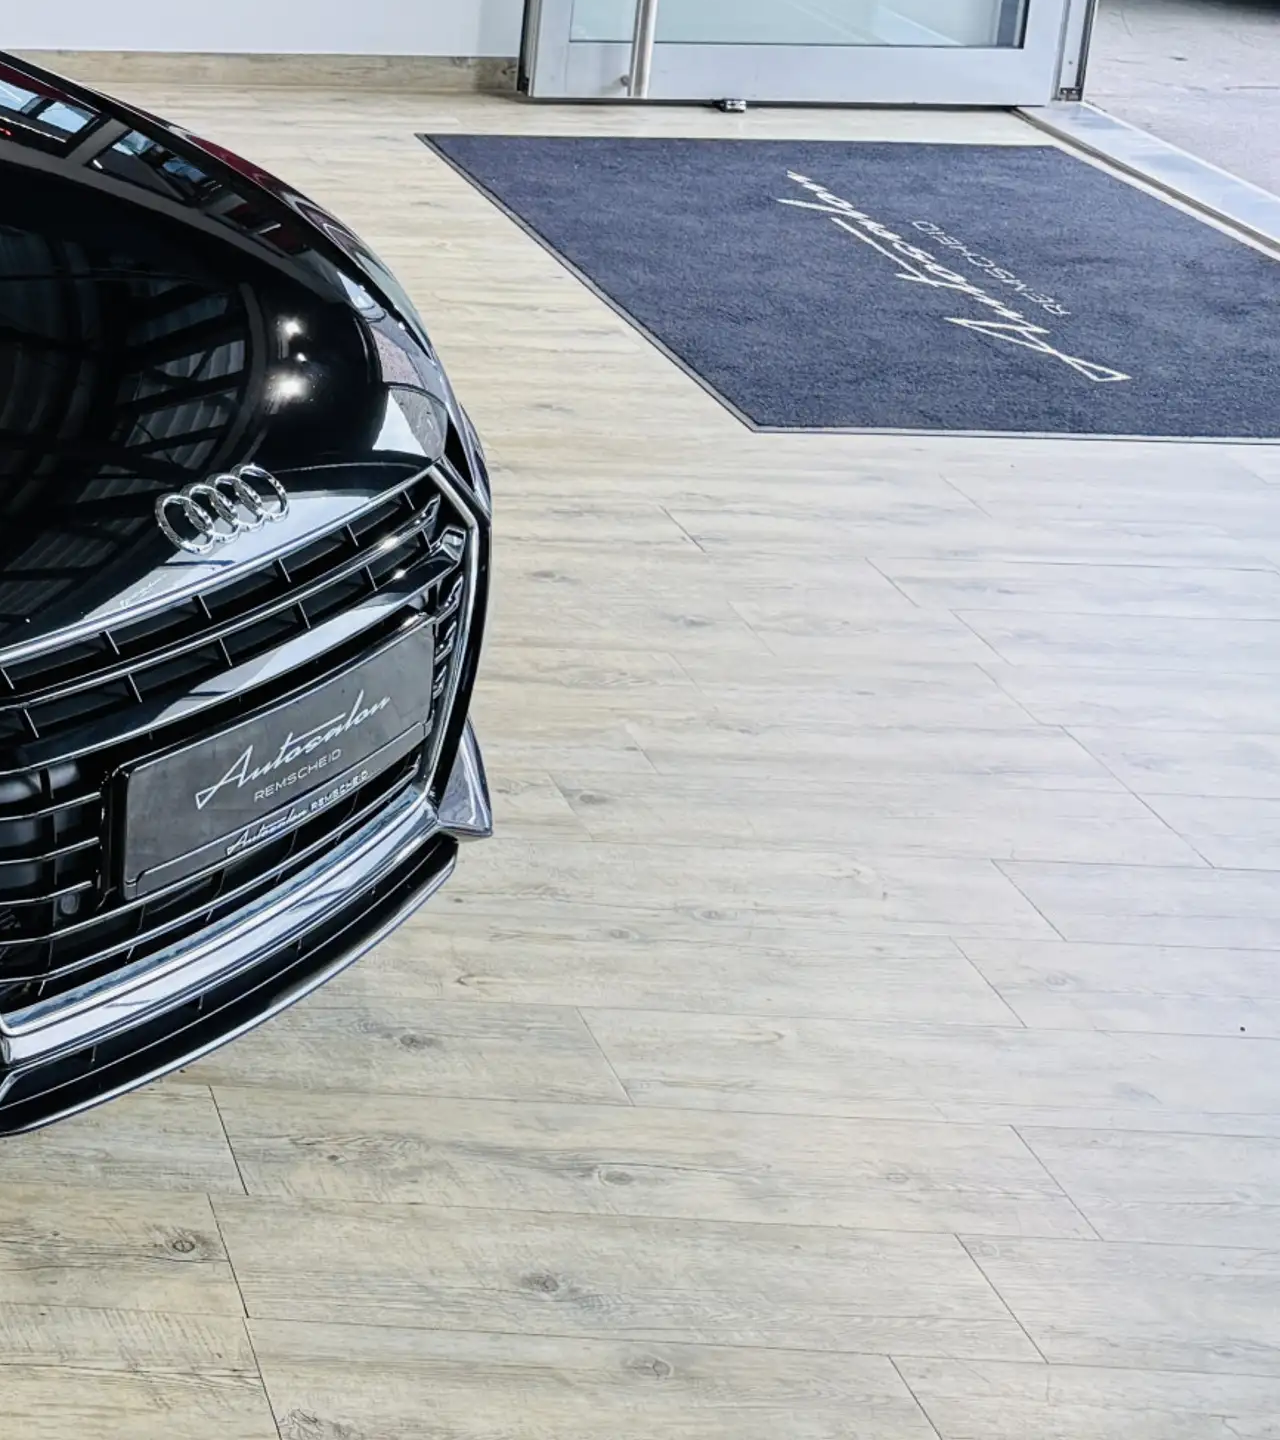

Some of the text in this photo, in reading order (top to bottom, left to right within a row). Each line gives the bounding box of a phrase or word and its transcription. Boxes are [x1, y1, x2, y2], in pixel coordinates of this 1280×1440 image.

[778, 170, 1132, 382] Autosalon
[912, 220, 1071, 316] REMSCHEID
[195, 689, 391, 810] Autosalon
[253, 748, 343, 804] REMSCHEID
